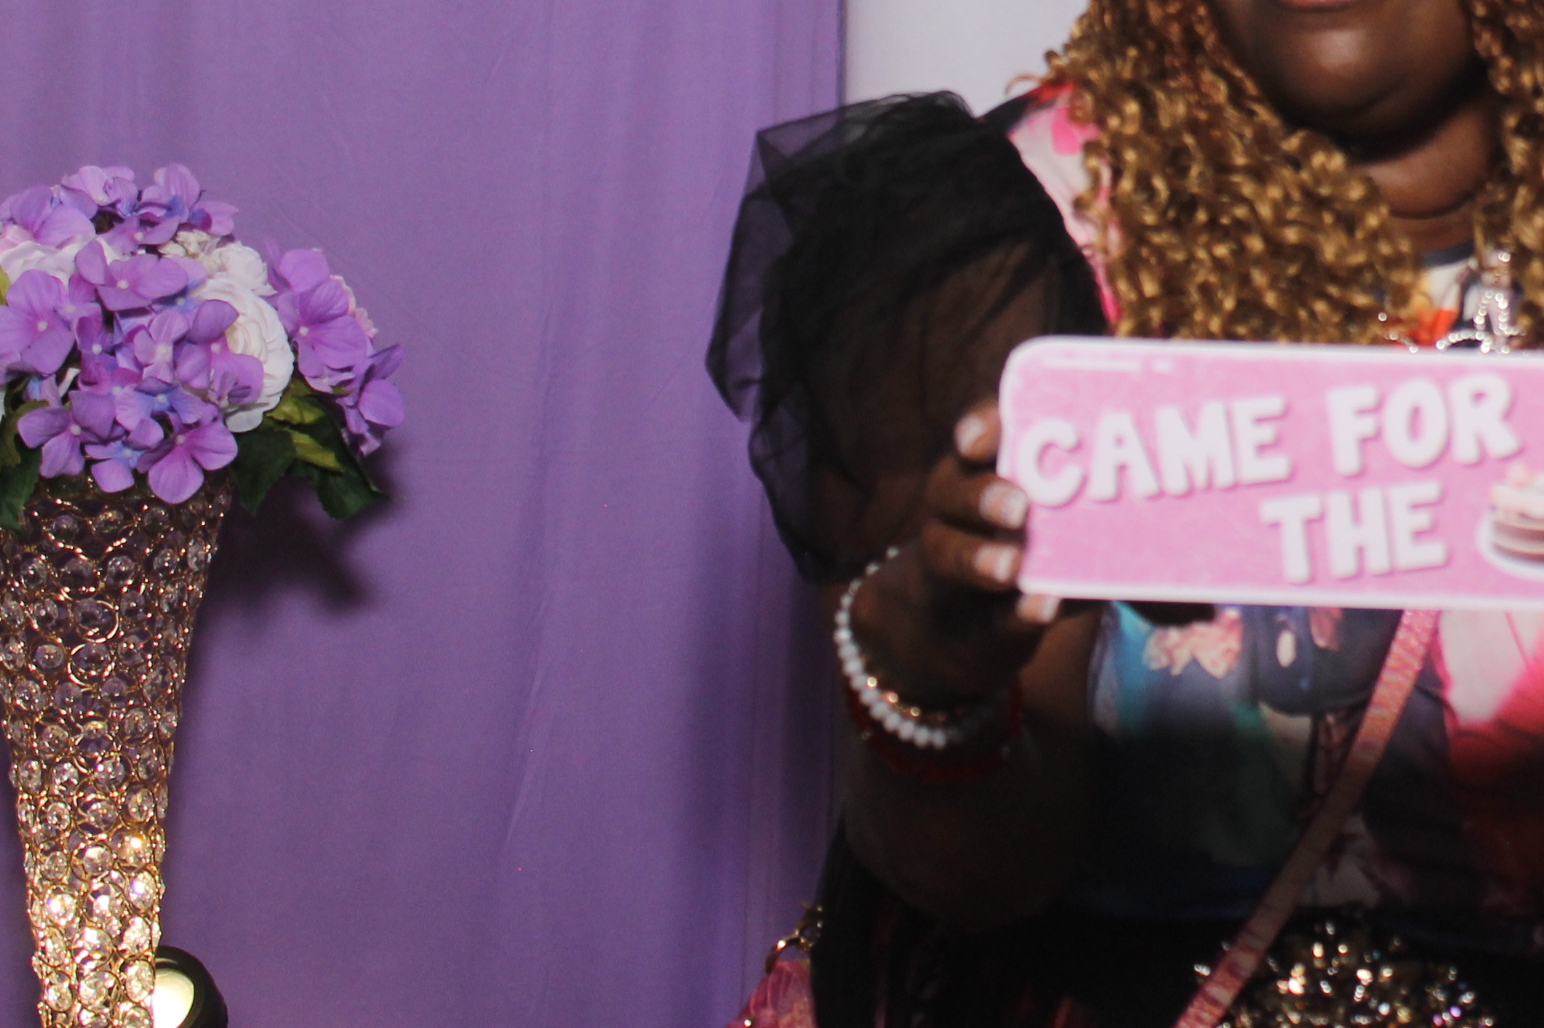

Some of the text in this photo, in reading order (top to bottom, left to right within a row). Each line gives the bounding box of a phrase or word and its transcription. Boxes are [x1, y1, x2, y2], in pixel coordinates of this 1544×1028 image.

[1017, 374, 1523, 506] CAME FOR
[1261, 482, 1448, 585] THE
